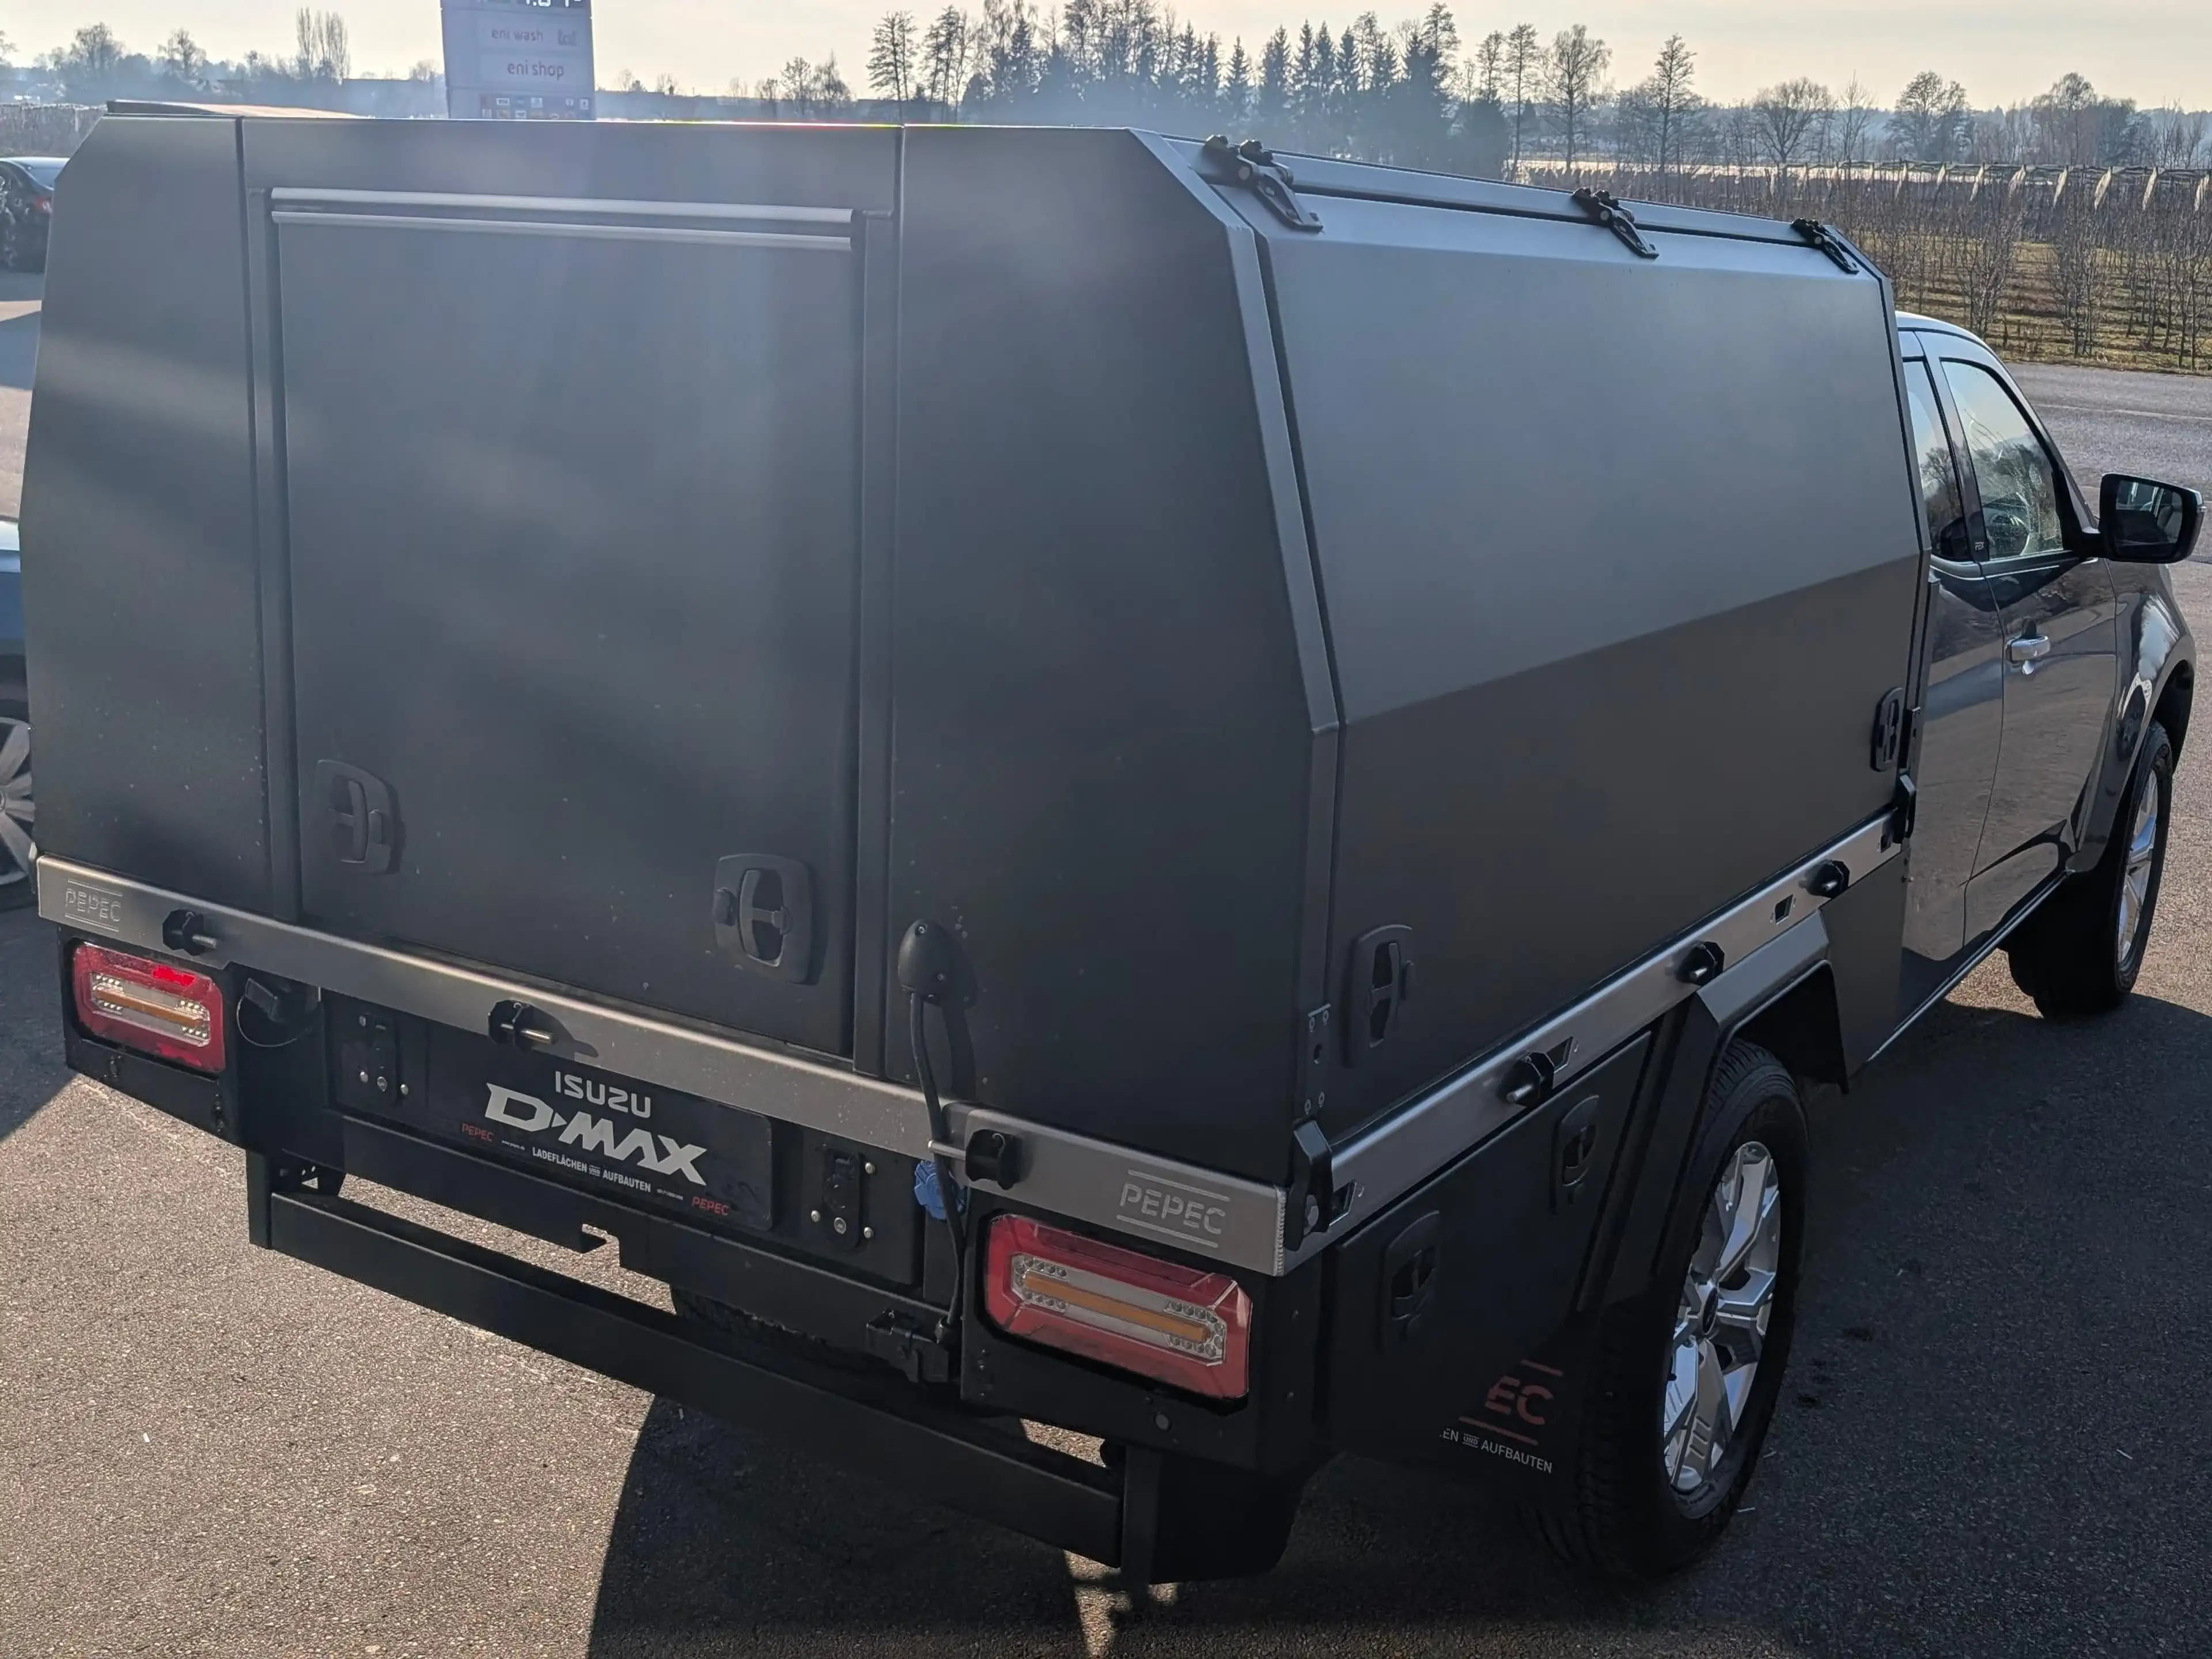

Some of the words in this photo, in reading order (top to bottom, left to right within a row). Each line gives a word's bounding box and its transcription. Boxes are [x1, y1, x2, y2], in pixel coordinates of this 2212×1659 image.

[491, 28, 510, 40] eni
[513, 29, 543, 42] wash
[507, 60, 528, 75] eni
[532, 60, 565, 80] shop
[65, 888, 122, 922] PEPEC
[555, 1070, 651, 1118] ISUZU
[461, 1122, 495, 1142] PEPEC
[532, 1146, 588, 1173] LADEFLÄCHEN
[603, 1169, 652, 1193] AUFBAUTEN
[691, 1196, 730, 1215] PEPEC
[1119, 1183, 1226, 1235] PEPEC
[1480, 1440, 1553, 1474] AUFBAUTEN
